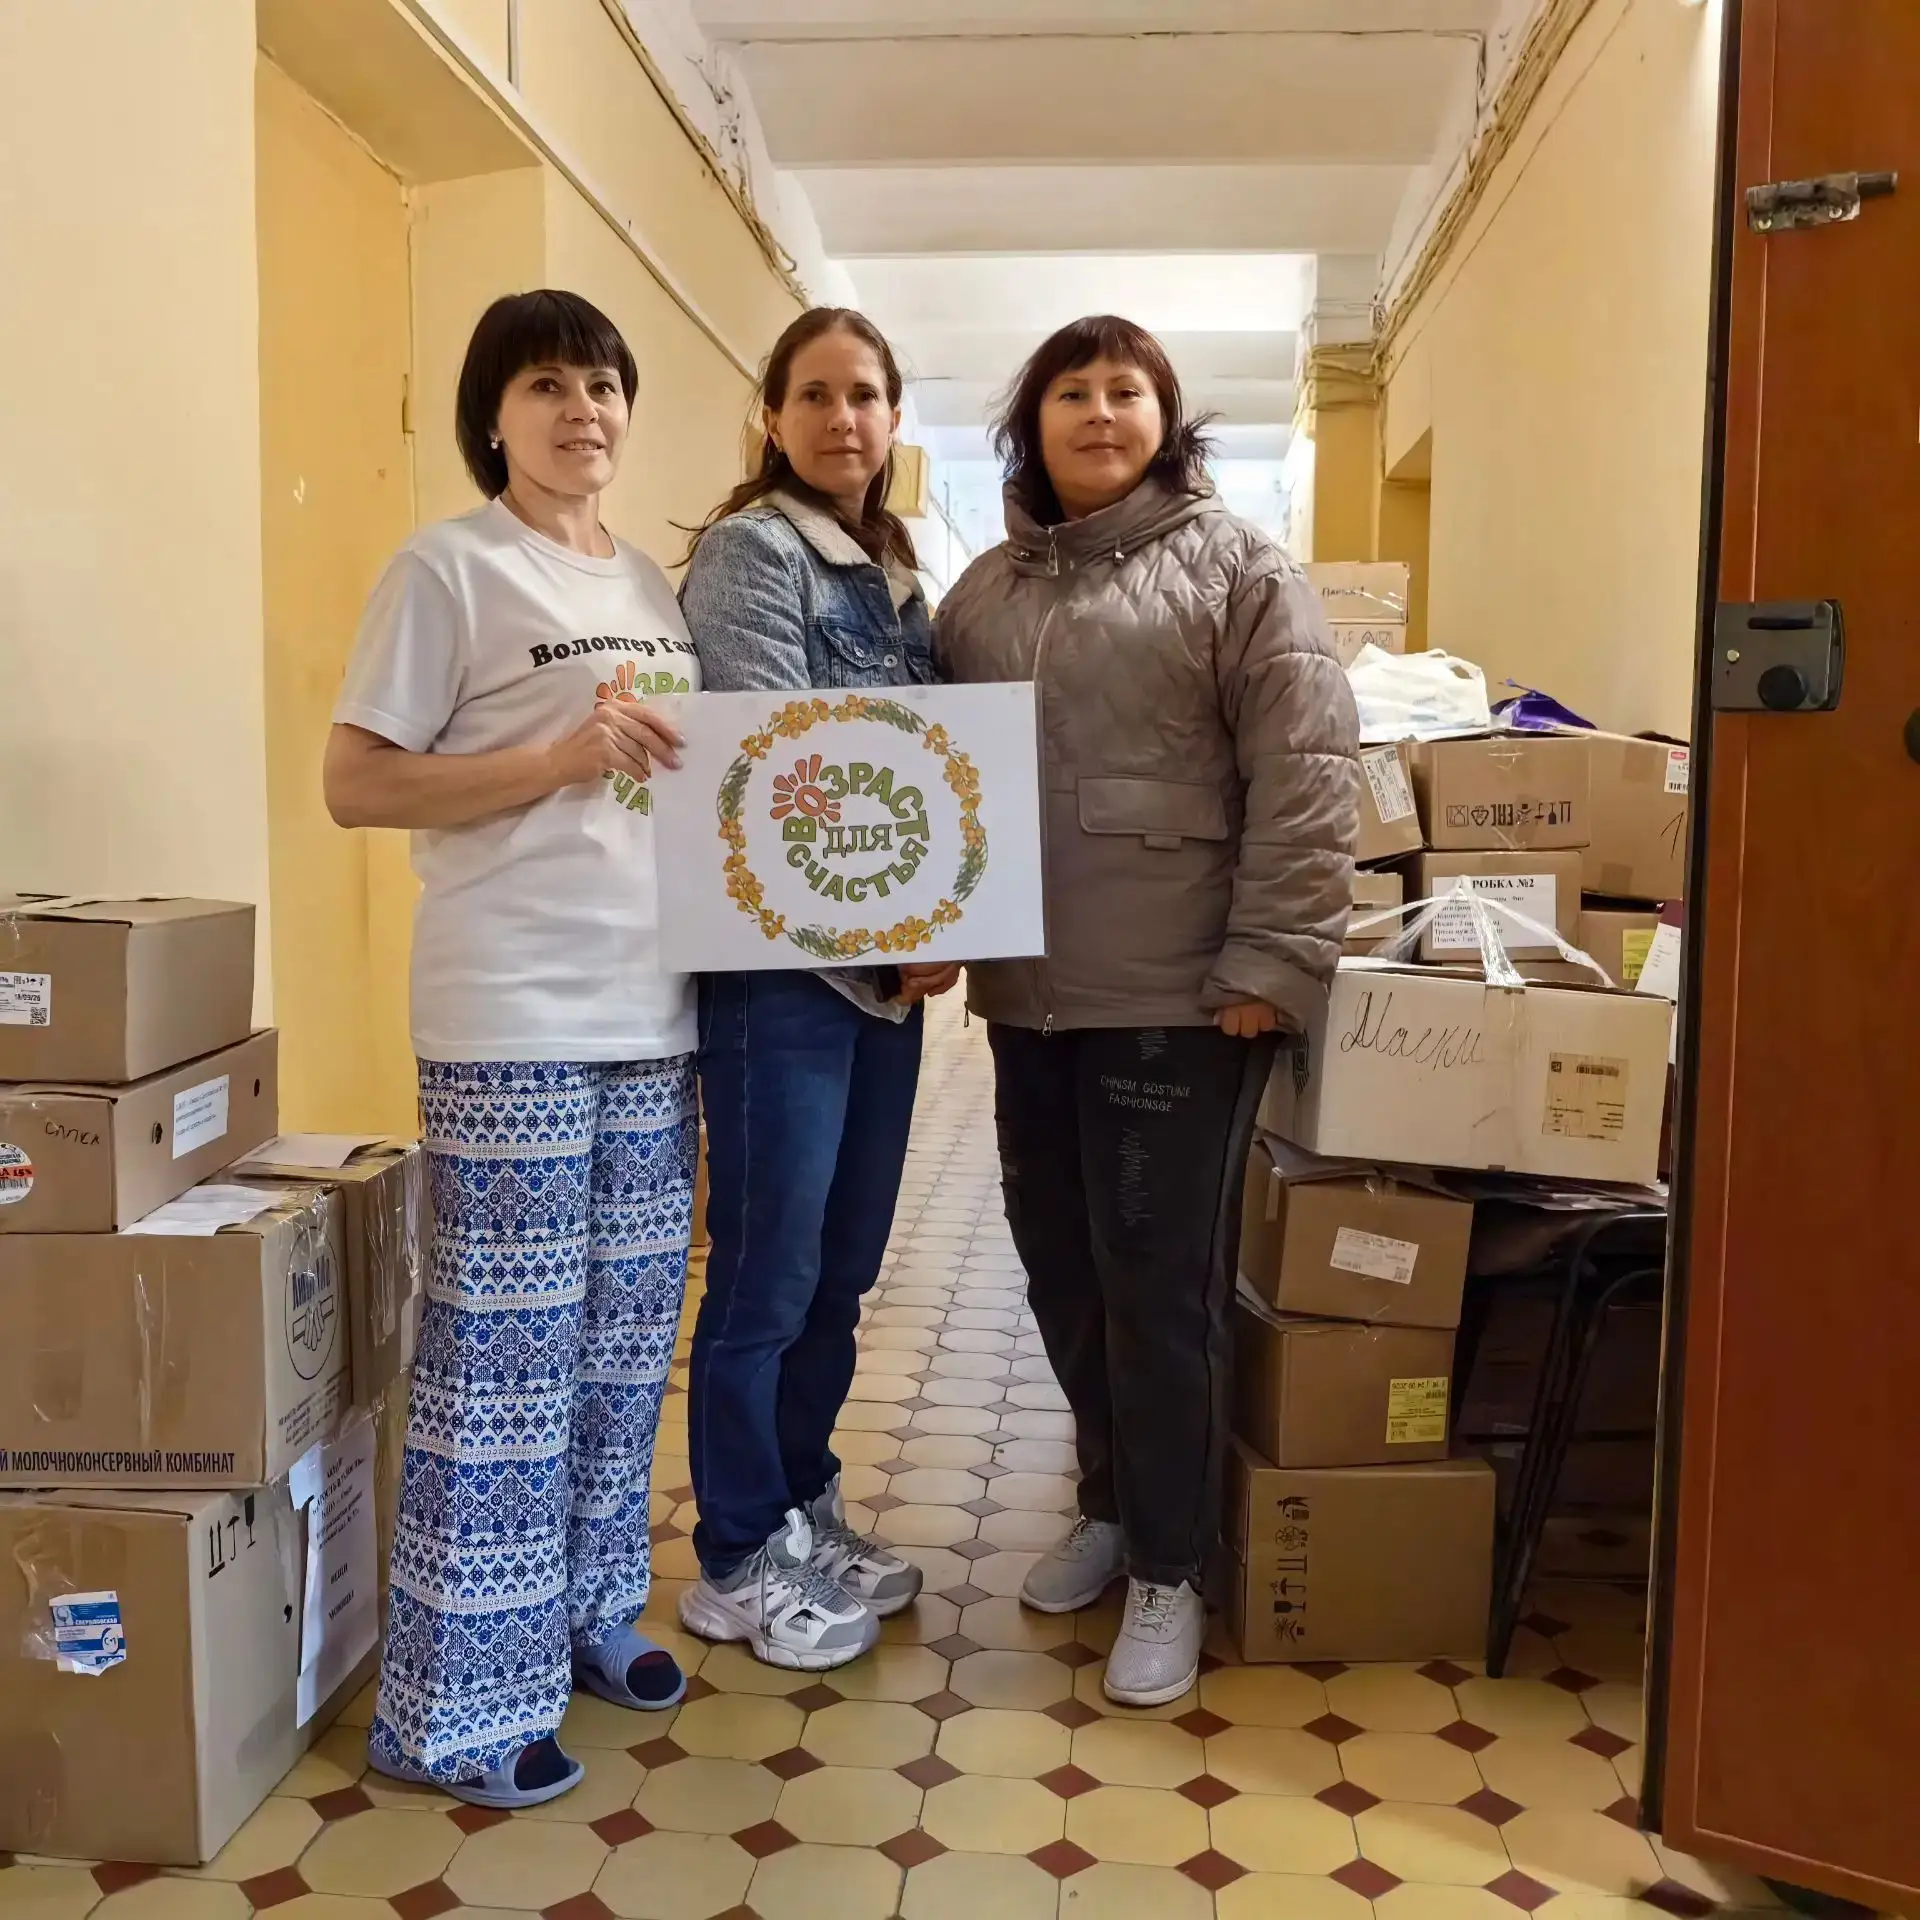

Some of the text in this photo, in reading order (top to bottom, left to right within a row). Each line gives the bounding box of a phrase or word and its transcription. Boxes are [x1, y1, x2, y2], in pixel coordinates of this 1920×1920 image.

[529, 636, 656, 668] Волонтер
[782, 762, 930, 842] ВОЗРАСТ
[823, 824, 893, 859] ДЛЯ
[786, 837, 929, 903] СЧАСТЬЯ
[1459, 878, 1514, 890] РОБКА
[12, 1450, 162, 1473] МОЛОЧНОКОНСЕРВНЫЙ
[166, 1452, 235, 1473] КОМБИНАТ
